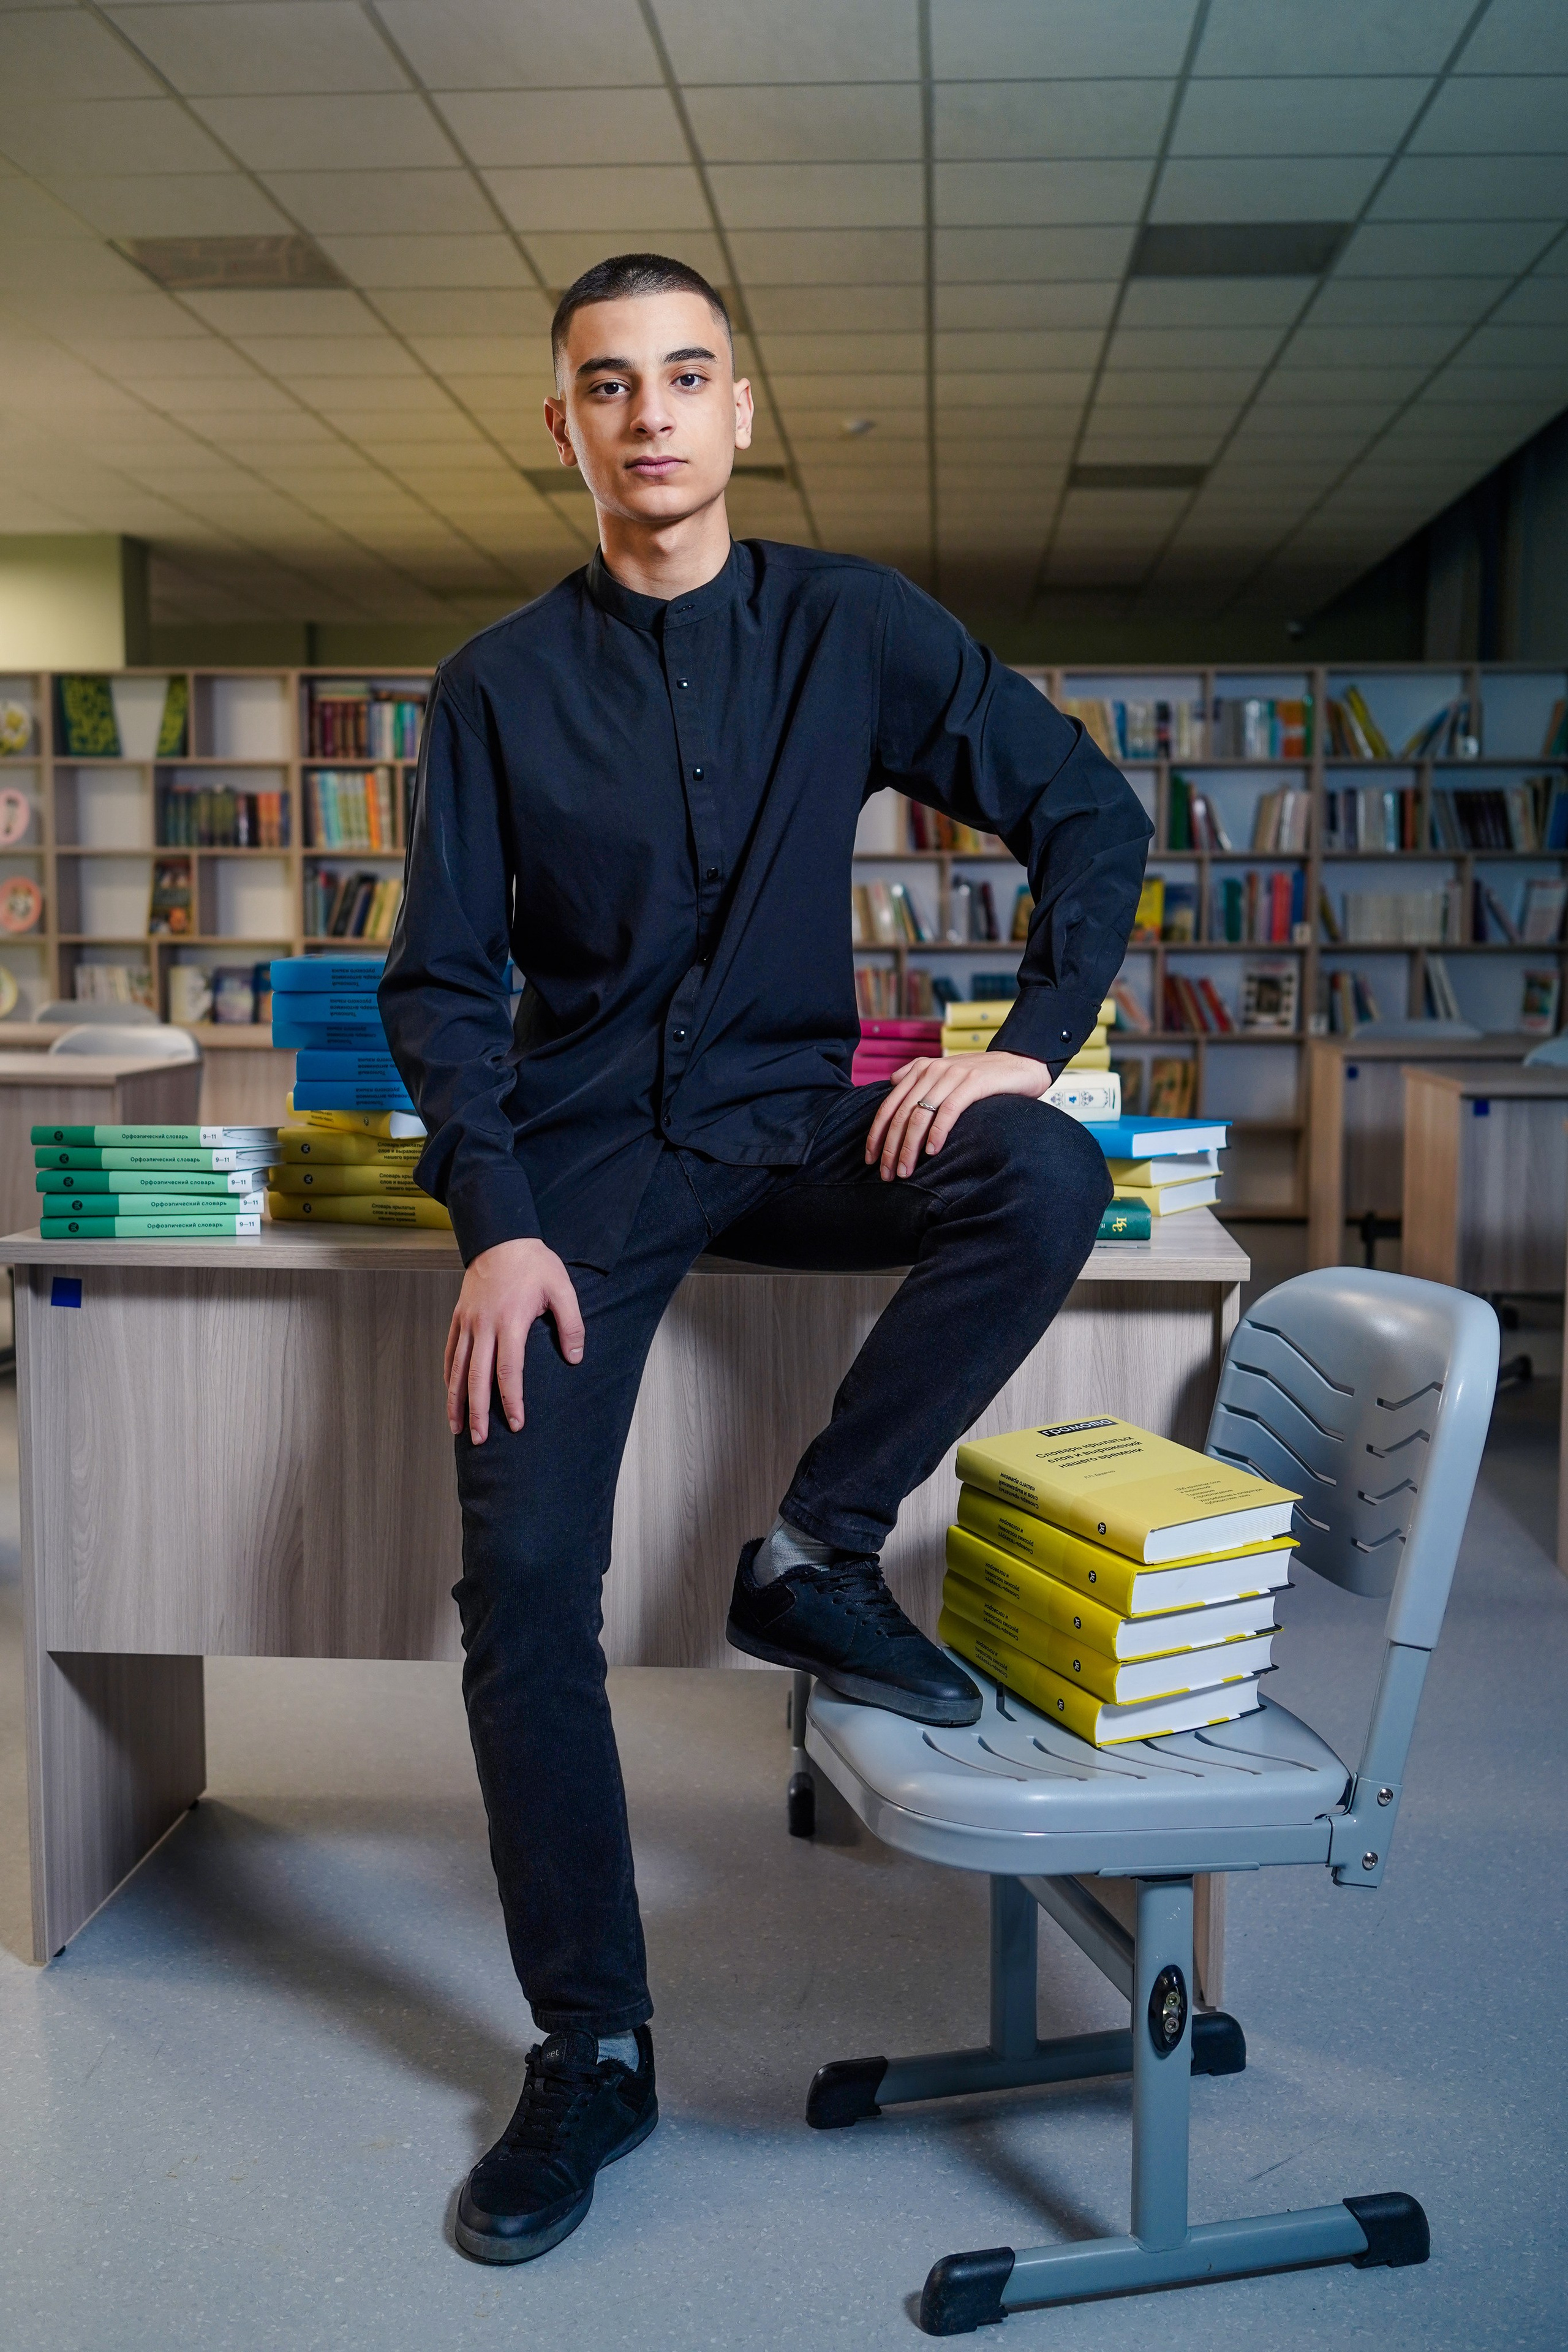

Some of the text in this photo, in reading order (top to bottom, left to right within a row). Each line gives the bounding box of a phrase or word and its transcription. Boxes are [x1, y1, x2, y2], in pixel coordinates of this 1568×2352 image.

[1042, 1419, 1113, 1436] грамота
[1036, 1436, 1134, 1459] Словарь крылатых
[1047, 1454, 1074, 1463] слов
[1082, 1441, 1143, 1455] выражений
[1058, 1448, 1144, 1468] нашего времени
[999, 1480, 1023, 1494] выражений
[1000, 1472, 1035, 1491] нашего времени
[999, 1487, 1039, 1509] Словарь крылатых
[998, 1524, 1034, 1546] русских пословиц
[999, 1518, 1020, 1531] поговорок
[998, 1532, 1033, 1555] Словарь-тезаурус
[985, 1562, 1006, 1577] поговорок
[985, 1569, 1019, 1591] русских пословиц
[986, 1577, 1019, 1599] Словарь-тезаурус
[984, 1604, 1005, 1618] поговорок
[984, 1610, 1019, 1633] русских пословиц
[984, 1617, 1019, 1641] Словарь-тезаурус
